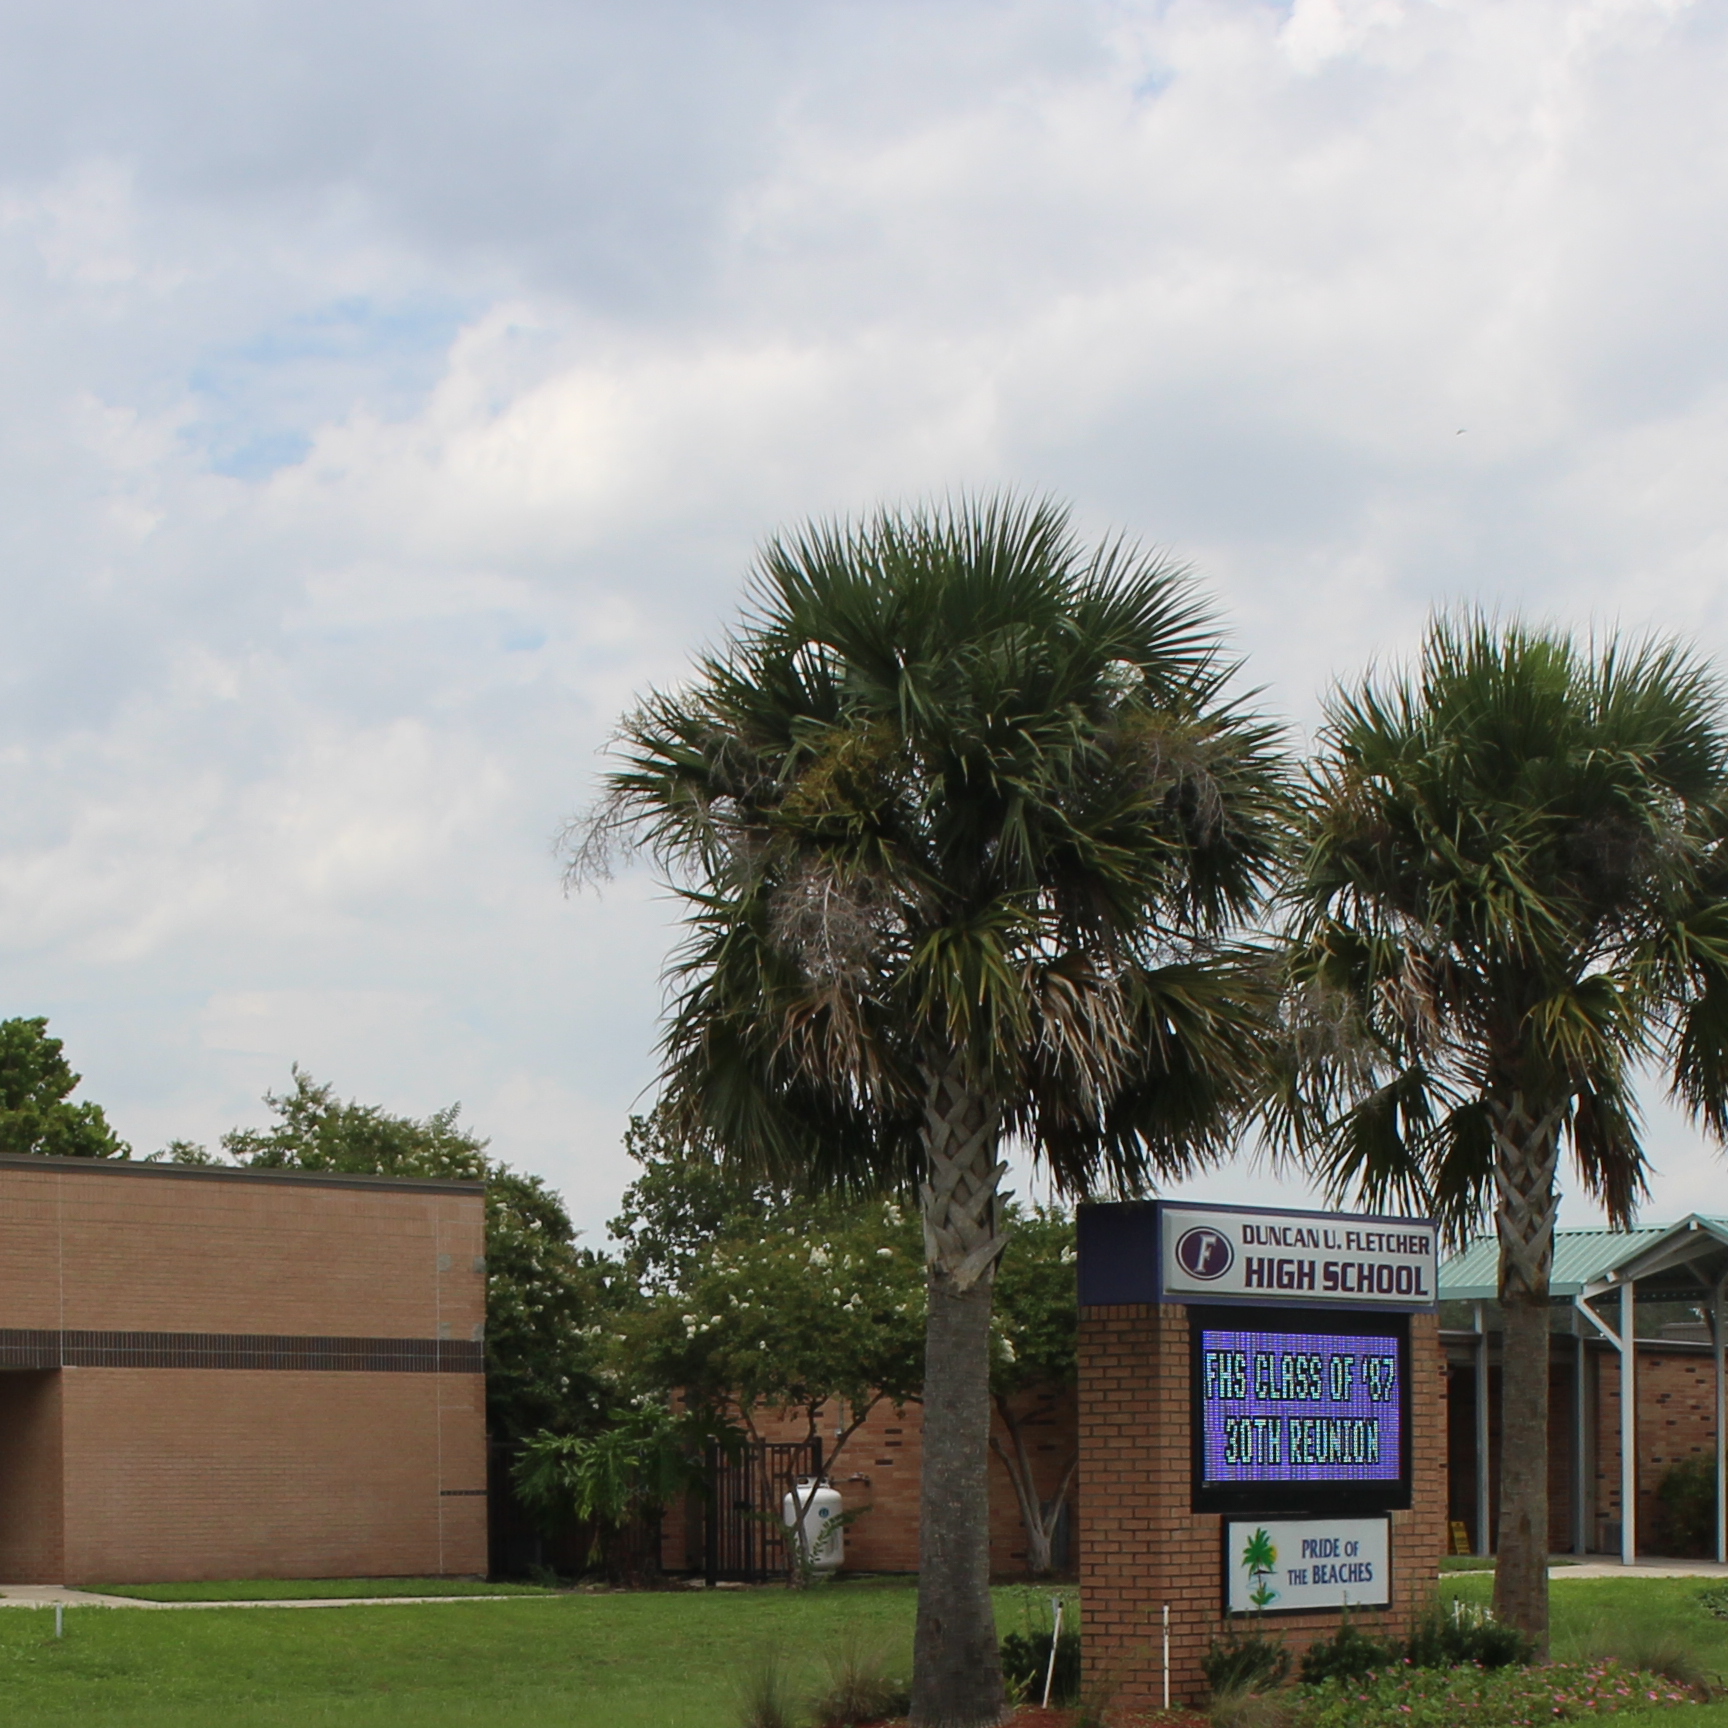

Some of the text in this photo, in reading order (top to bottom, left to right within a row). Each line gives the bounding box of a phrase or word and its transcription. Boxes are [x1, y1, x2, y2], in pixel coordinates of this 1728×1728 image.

[1242, 1224, 1430, 1255] DUNCAN U. FLETCHER
[1245, 1256, 1429, 1296] HIGH SCHOOL
[1206, 1352, 1394, 1401] FHS CLASS OF '87
[1225, 1418, 1379, 1464] 30TH REUNION
[1302, 1538, 1340, 1559] PRIDE
[1288, 1562, 1373, 1586] THE BEACHES
